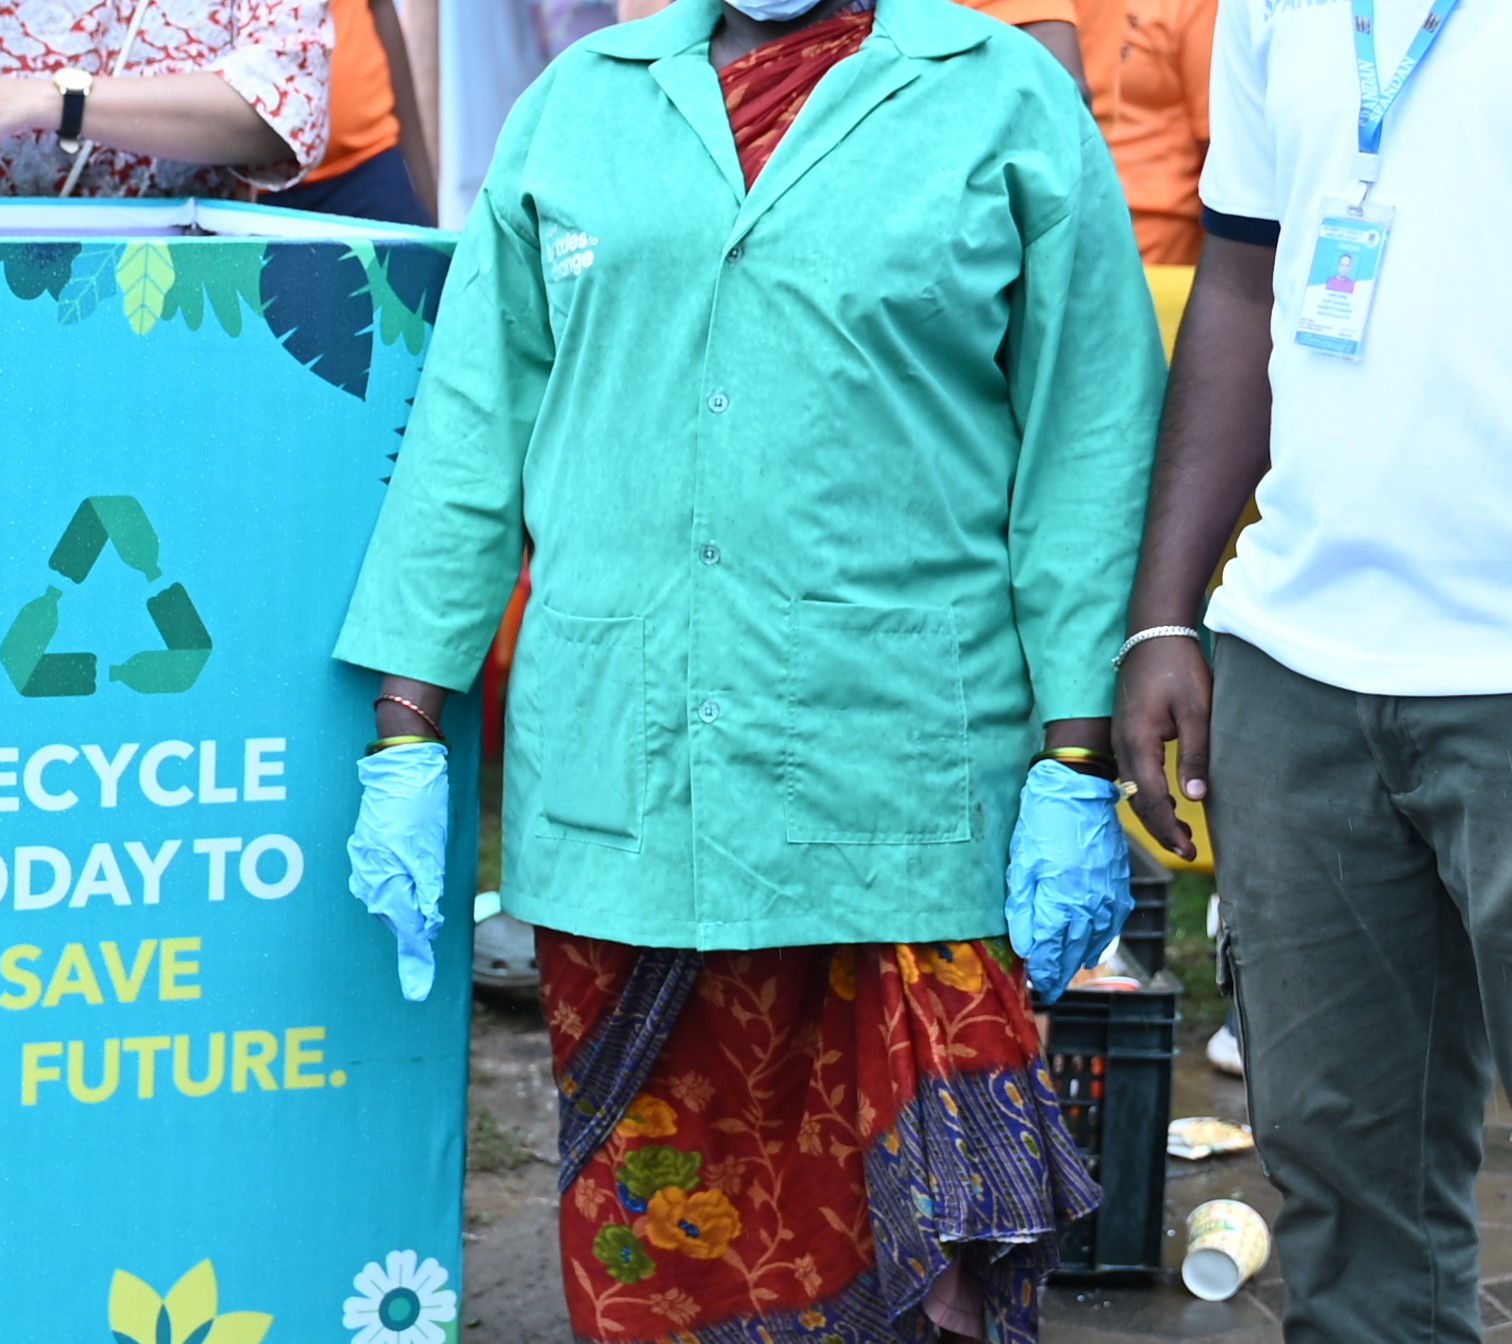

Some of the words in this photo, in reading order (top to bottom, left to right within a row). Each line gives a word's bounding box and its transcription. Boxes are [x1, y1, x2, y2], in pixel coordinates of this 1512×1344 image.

[1369, 56, 1416, 123] SPANDAN
[193, 833, 305, 902] TO
[21, 1026, 347, 1106] FUTURE.
